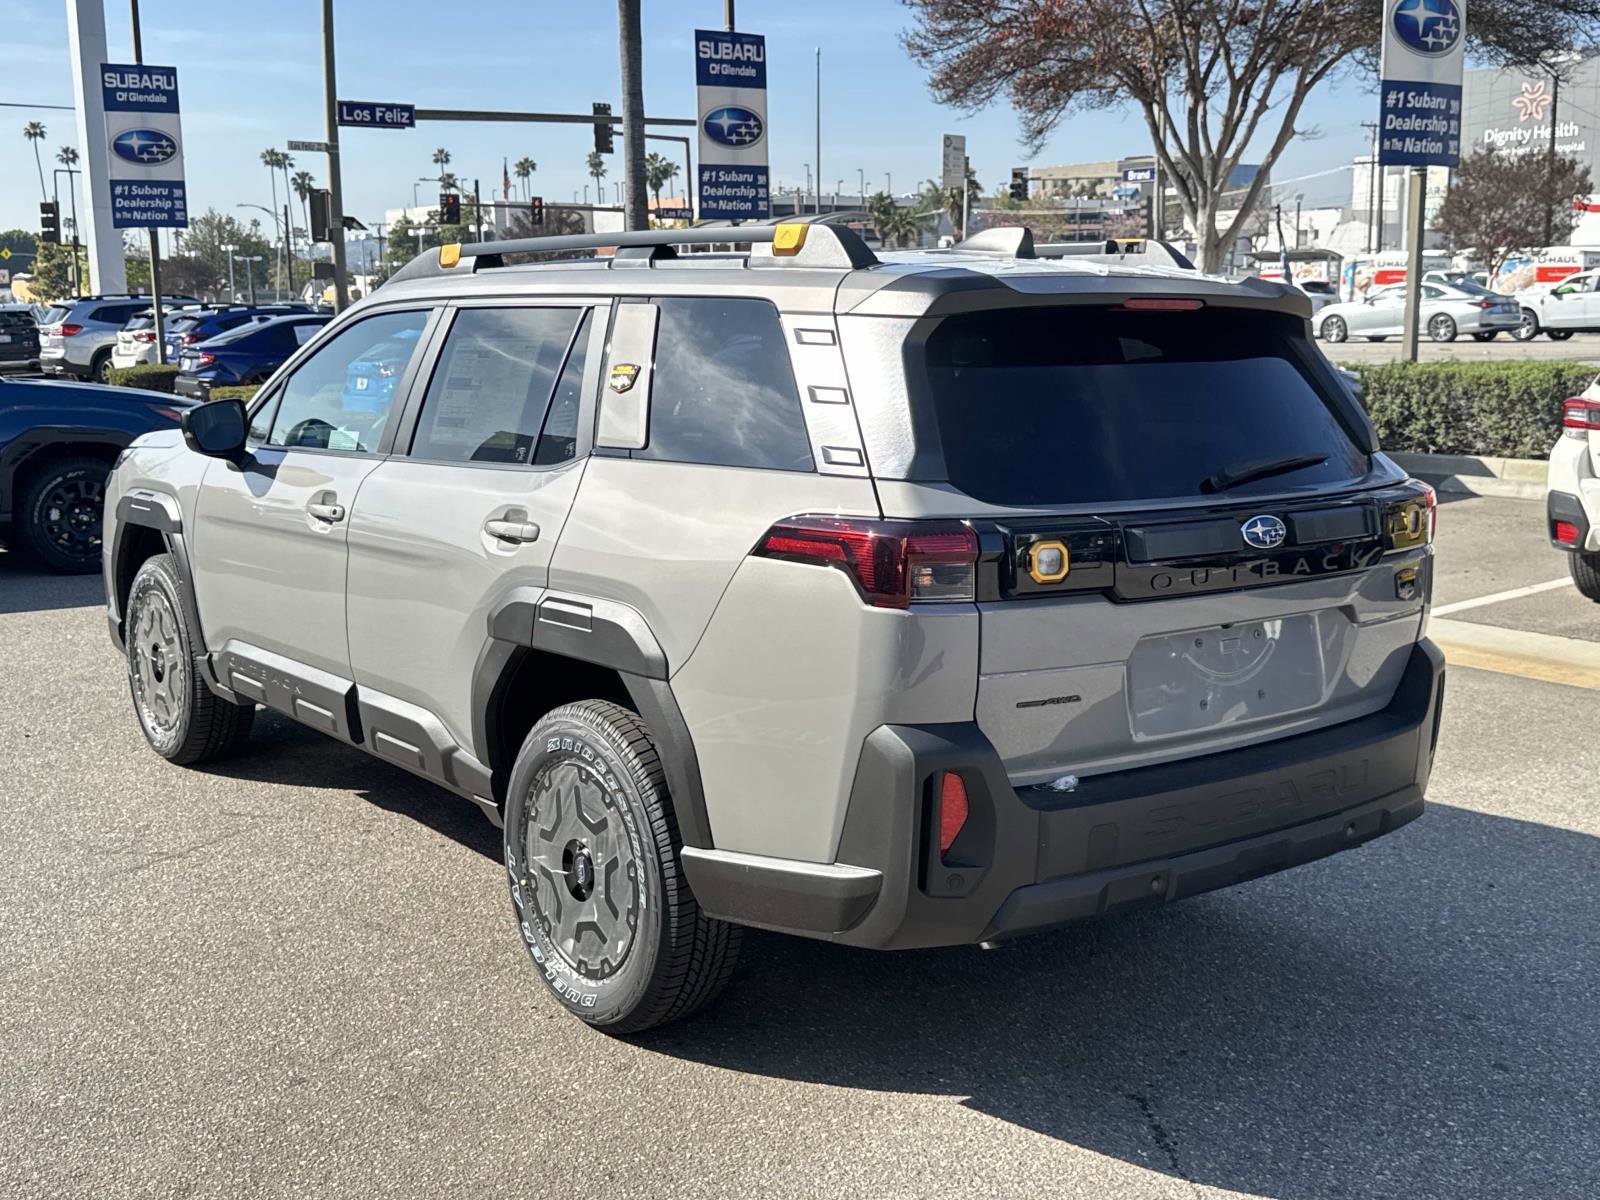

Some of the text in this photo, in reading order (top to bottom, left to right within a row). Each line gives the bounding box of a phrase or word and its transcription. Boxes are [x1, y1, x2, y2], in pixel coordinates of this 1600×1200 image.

[698, 40, 764, 62] SUBARU
[709, 63, 757, 77] Of Glendale
[103, 72, 176, 91] SUBARU
[116, 91, 167, 104] Of Glendale
[1386, 90, 1447, 111] #1 Subaru
[342, 104, 410, 124] Los Feliz
[1384, 113, 1449, 137] Dealership
[1484, 126, 1532, 147] Dignity
[1403, 137, 1444, 154] Nation
[702, 170, 753, 182] #1 Subaru
[1127, 170, 1151, 181] Brand
[114, 184, 169, 196] #1 Subaru
[702, 185, 756, 199] Dealership
[115, 197, 172, 210] Dealership
[718, 200, 752, 211] Nation
[132, 211, 168, 220] Nation
[1151, 545, 1365, 592] OUTBACK
[521, 921, 598, 1002] DUELER
